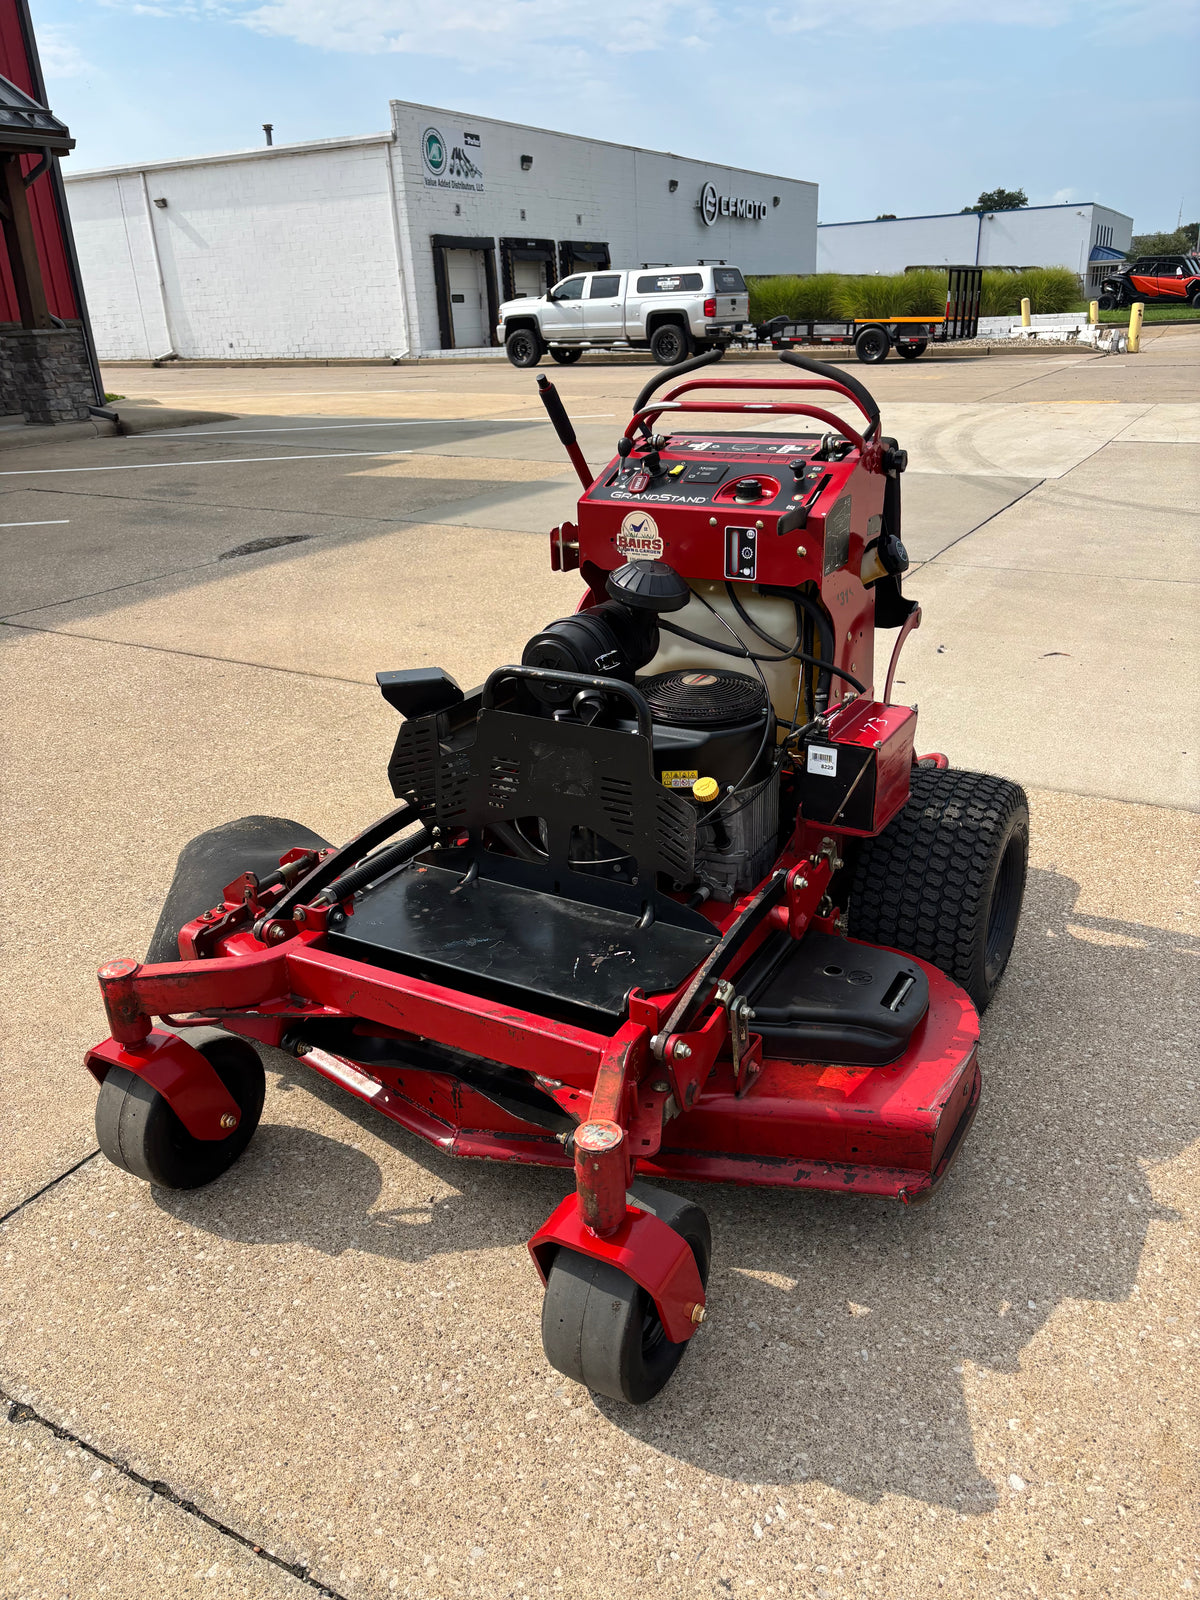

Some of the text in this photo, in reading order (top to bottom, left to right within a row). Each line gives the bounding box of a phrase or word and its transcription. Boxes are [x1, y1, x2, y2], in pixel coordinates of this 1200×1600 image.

[424, 177, 437, 187] Value
[438, 179, 450, 188] Added
[719, 196, 768, 219] CFMOTO
[619, 536, 662, 550] BAIRS
